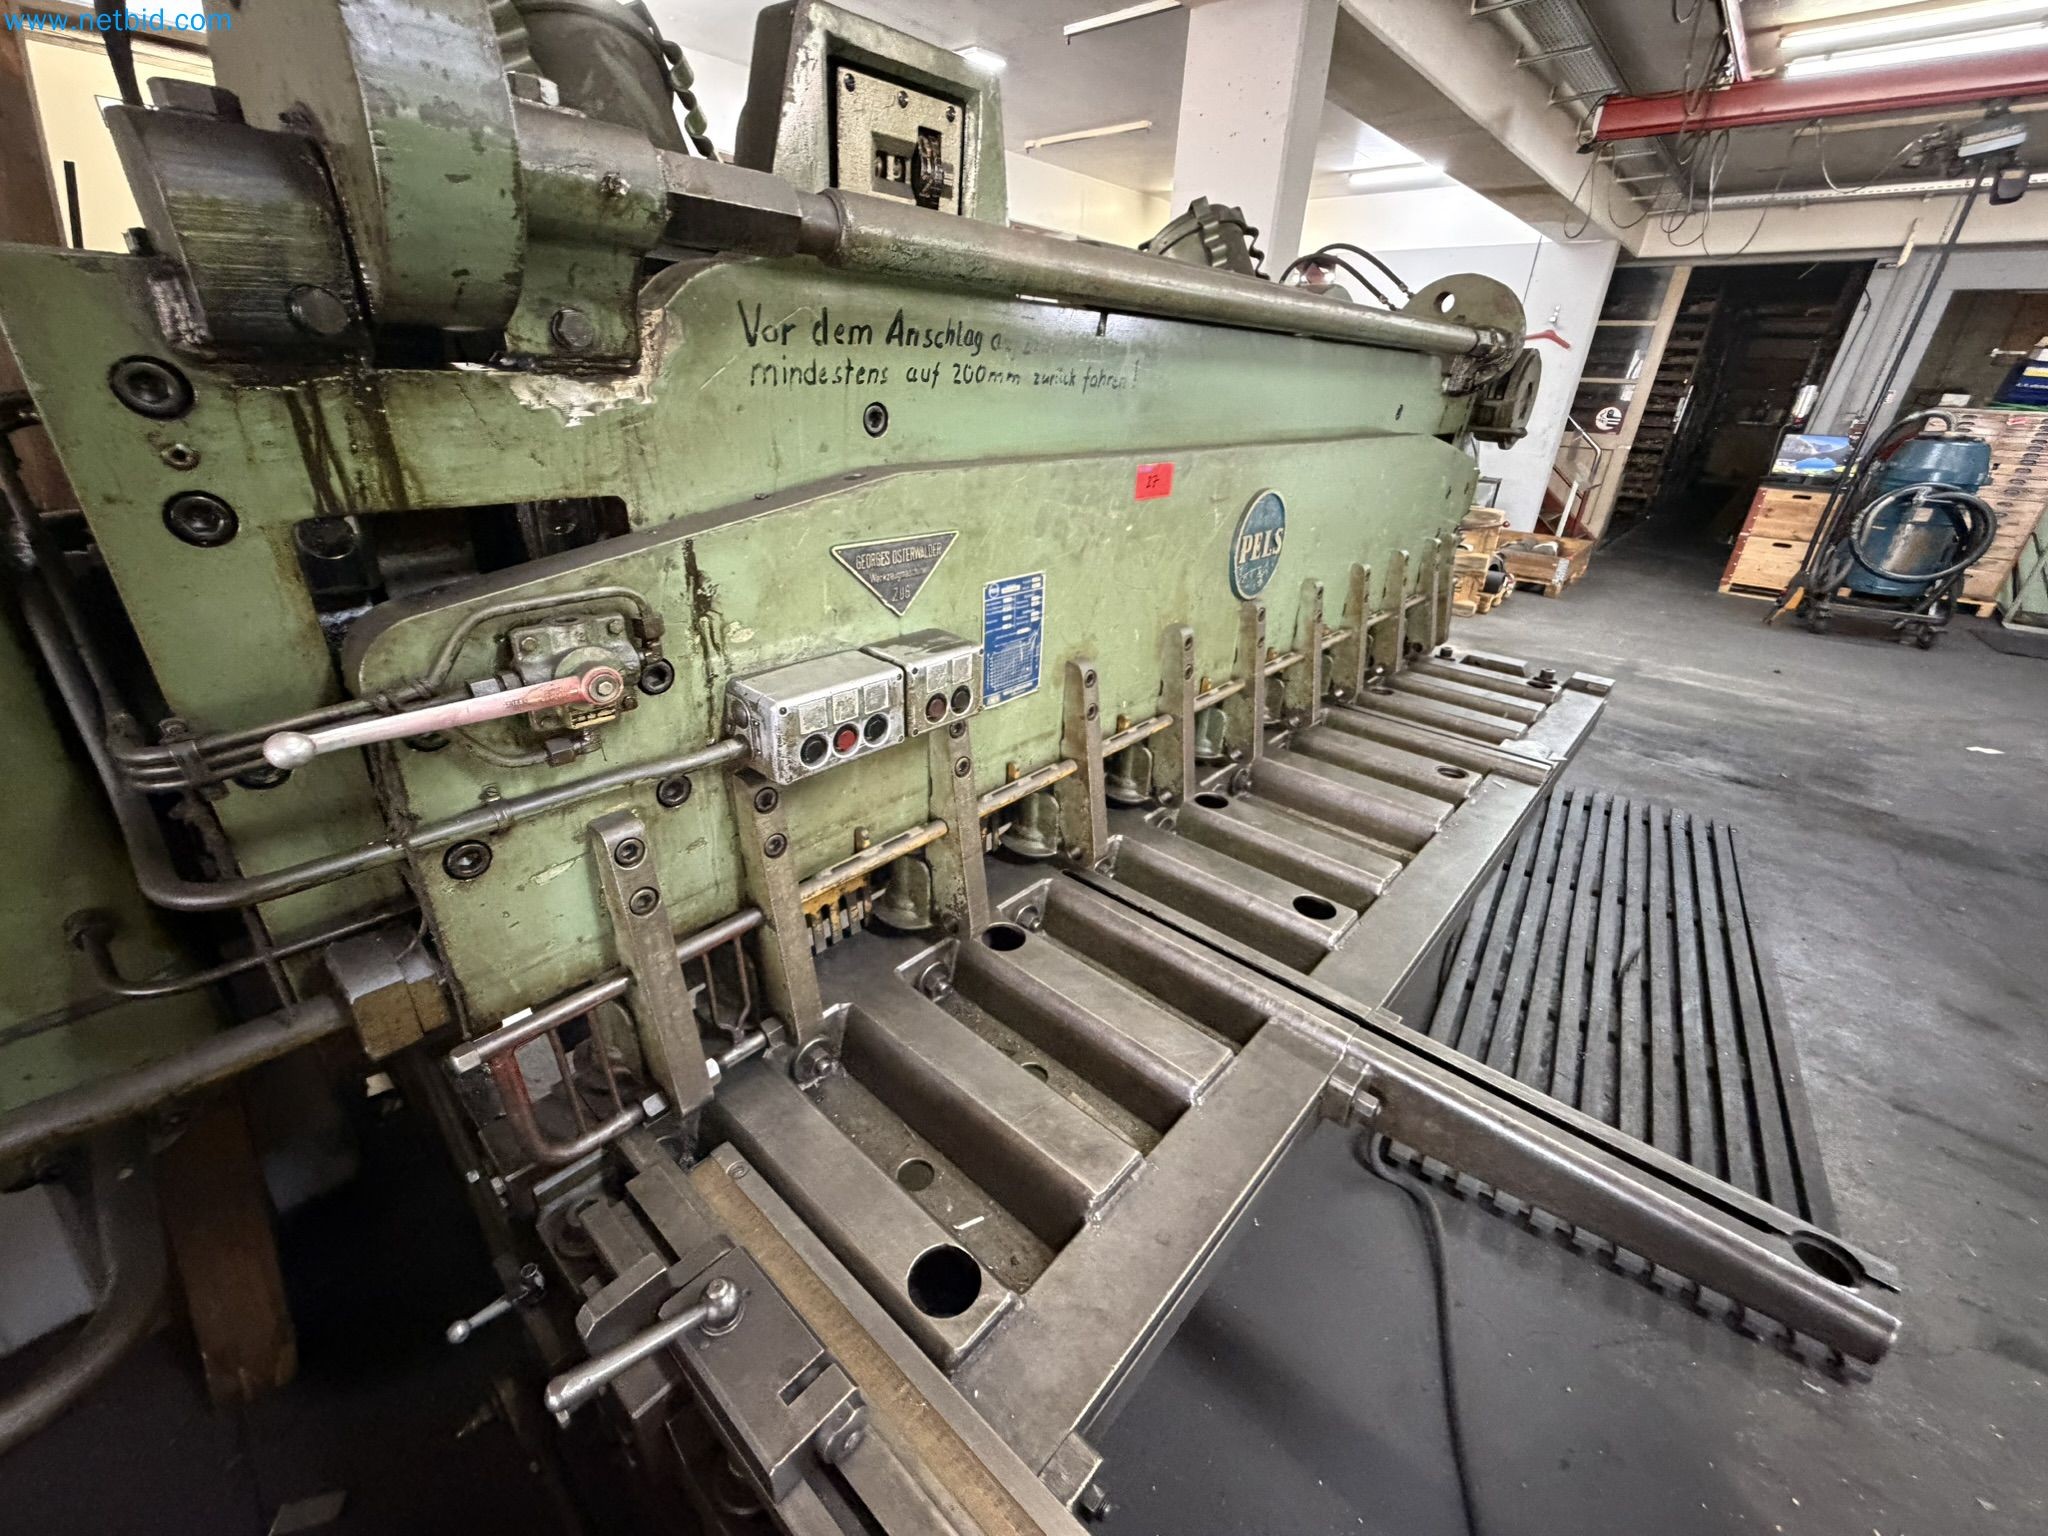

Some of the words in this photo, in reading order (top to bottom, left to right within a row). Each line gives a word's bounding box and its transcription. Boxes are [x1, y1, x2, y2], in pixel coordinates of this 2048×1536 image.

[737, 300, 796, 347] Vor
[812, 307, 872, 346] dem
[886, 308, 984, 357] Anschlag
[750, 357, 889, 388] mindestens
[905, 361, 940, 389] auf
[855, 550, 891, 570] GEORGES
[892, 542, 943, 565] OSTERWALDER
[1238, 527, 1284, 564] PELS
